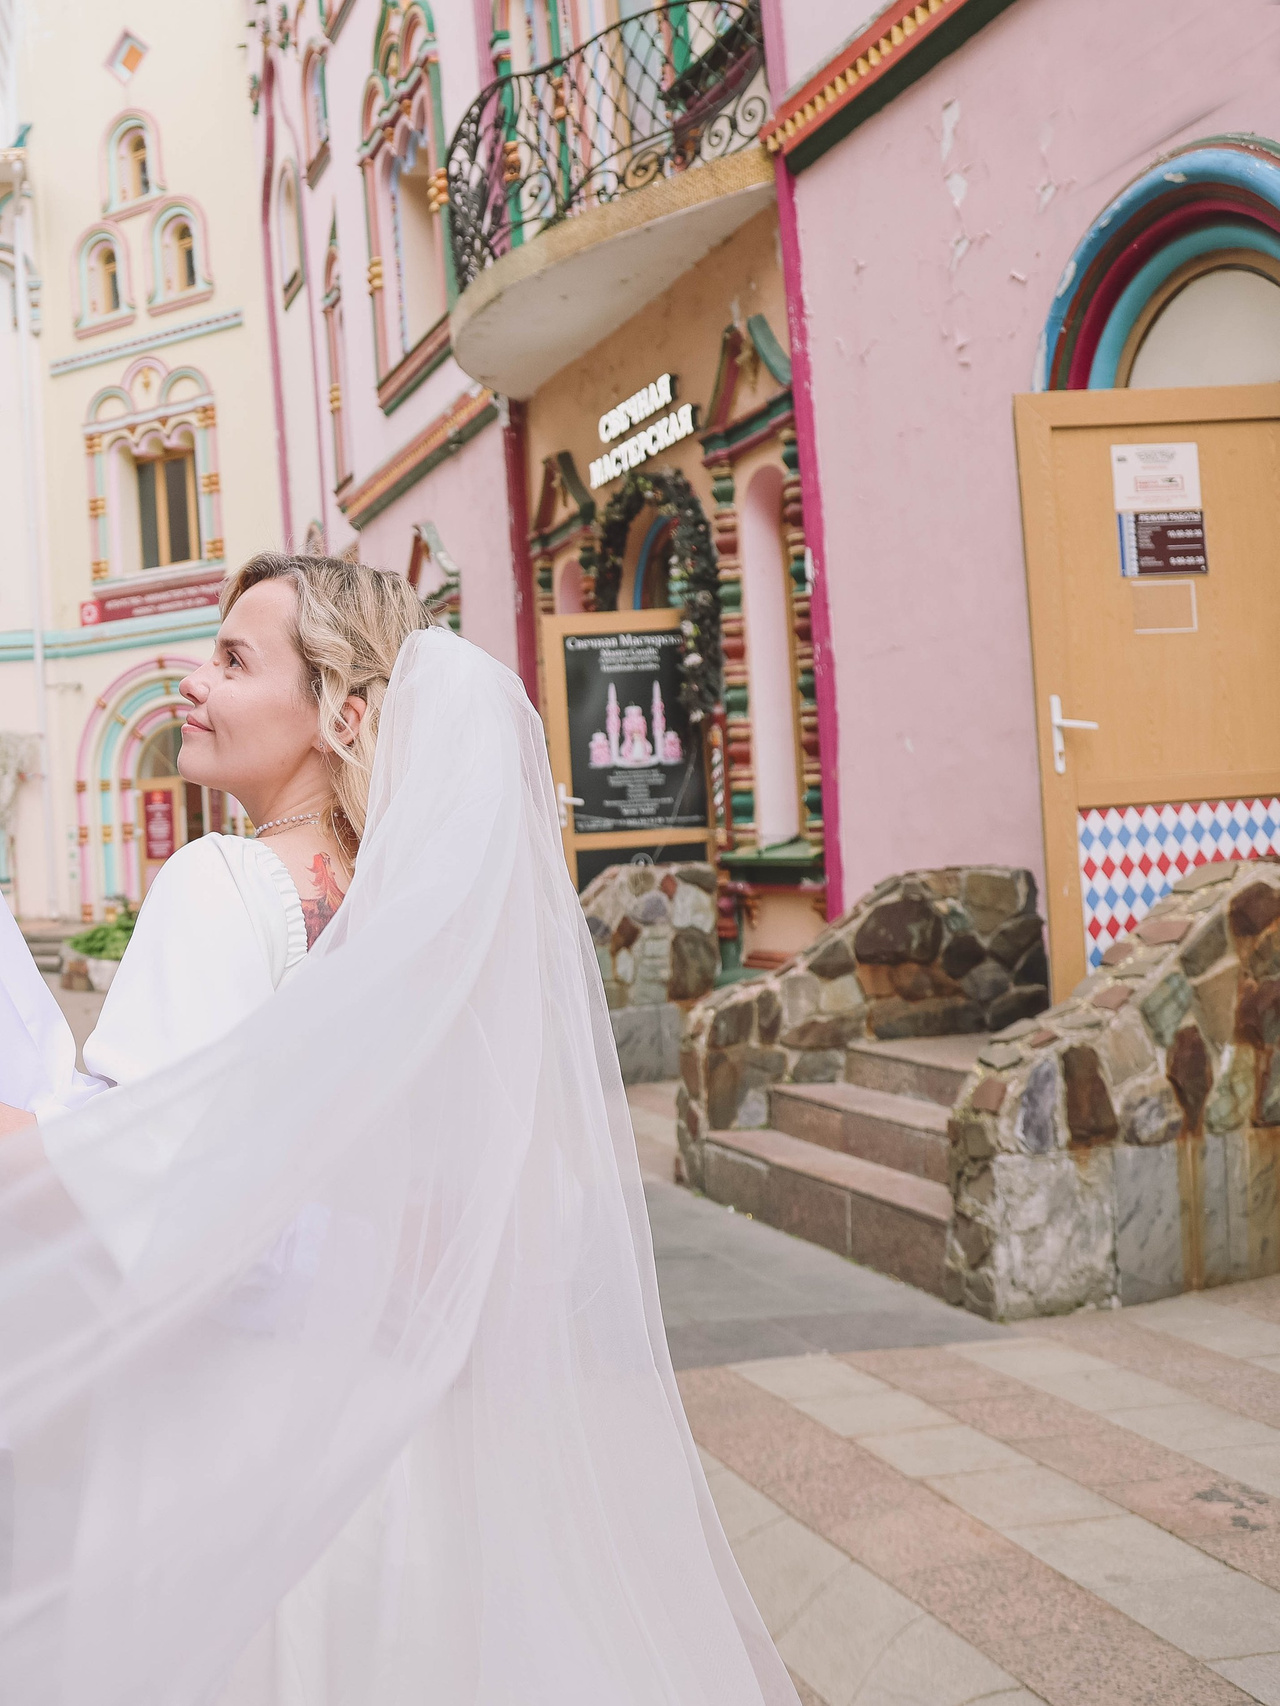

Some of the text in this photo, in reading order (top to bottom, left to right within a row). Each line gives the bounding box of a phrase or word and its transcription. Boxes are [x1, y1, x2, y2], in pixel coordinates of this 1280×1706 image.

[598, 373, 673, 443] СВЕЧНАЯ
[588, 403, 695, 490] МАСТЕРСКАЯ
[619, 633, 683, 650] Мастерска
